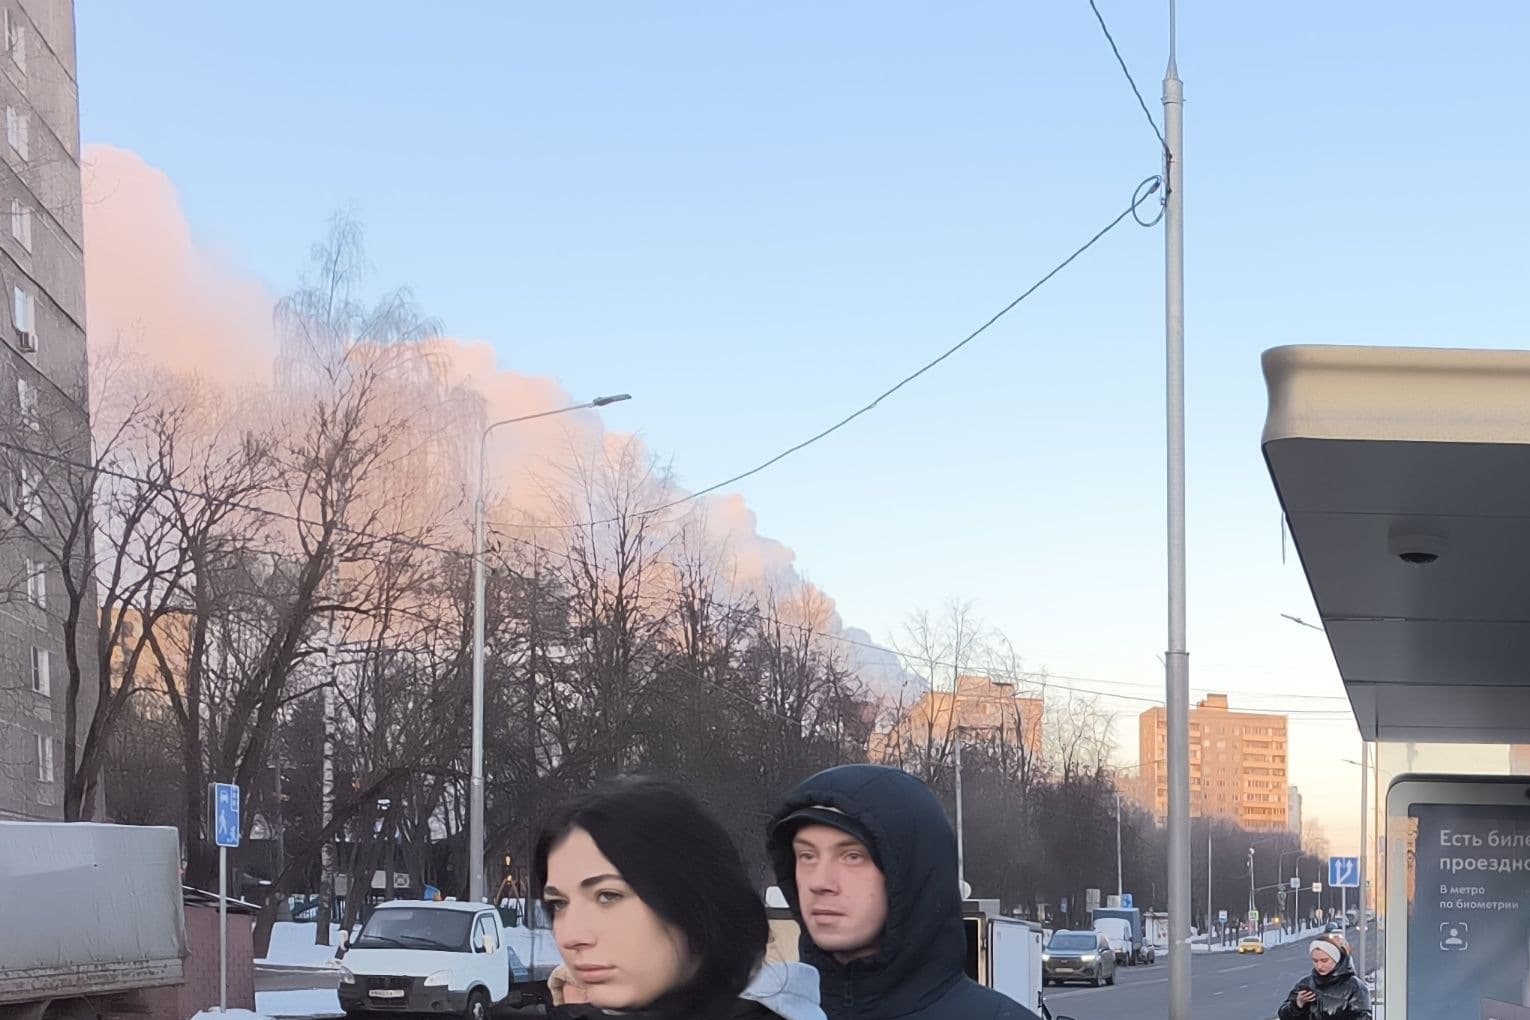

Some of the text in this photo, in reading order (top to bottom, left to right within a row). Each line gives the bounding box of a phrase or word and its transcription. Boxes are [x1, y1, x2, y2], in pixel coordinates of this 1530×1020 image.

[1439, 829, 1482, 847] Есть
[1439, 884, 1486, 897] В метро
[1439, 898, 1519, 911] по биометрии
